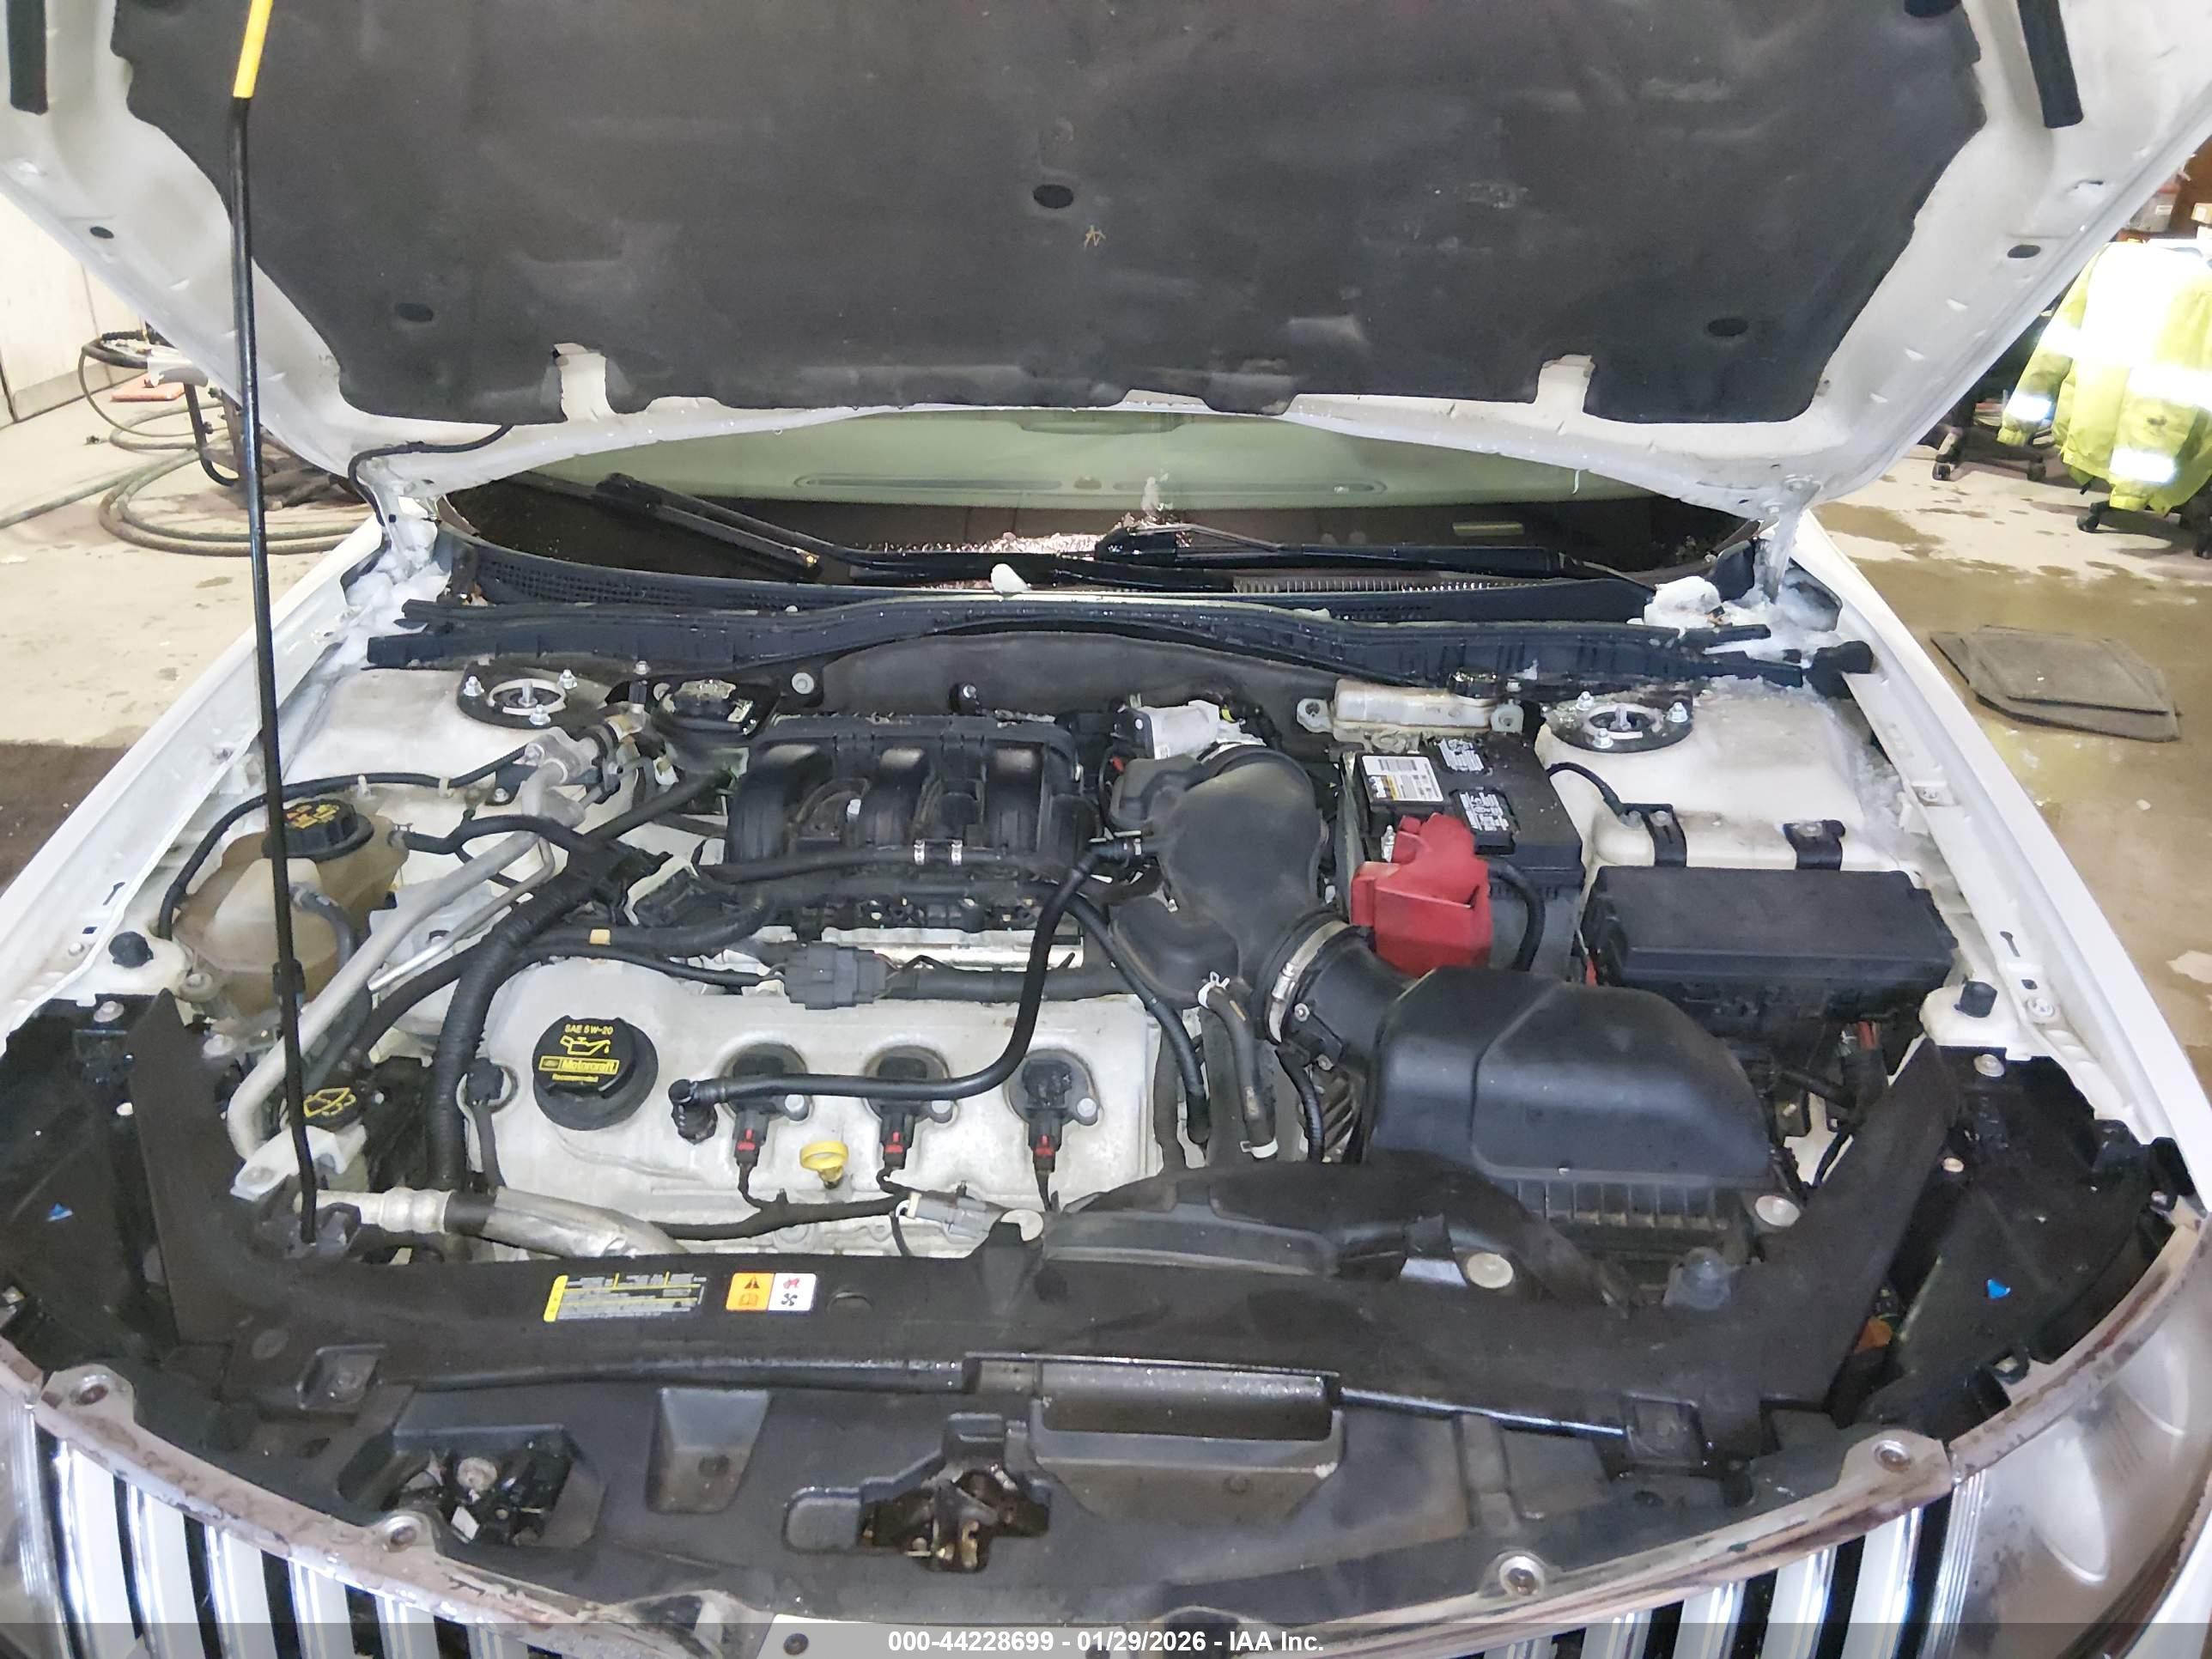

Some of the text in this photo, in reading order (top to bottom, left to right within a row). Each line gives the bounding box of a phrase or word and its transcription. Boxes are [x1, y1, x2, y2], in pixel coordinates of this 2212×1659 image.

[564, 1024, 614, 1035] SAE 5W-20
[562, 1059, 615, 1073] Motorcraft
